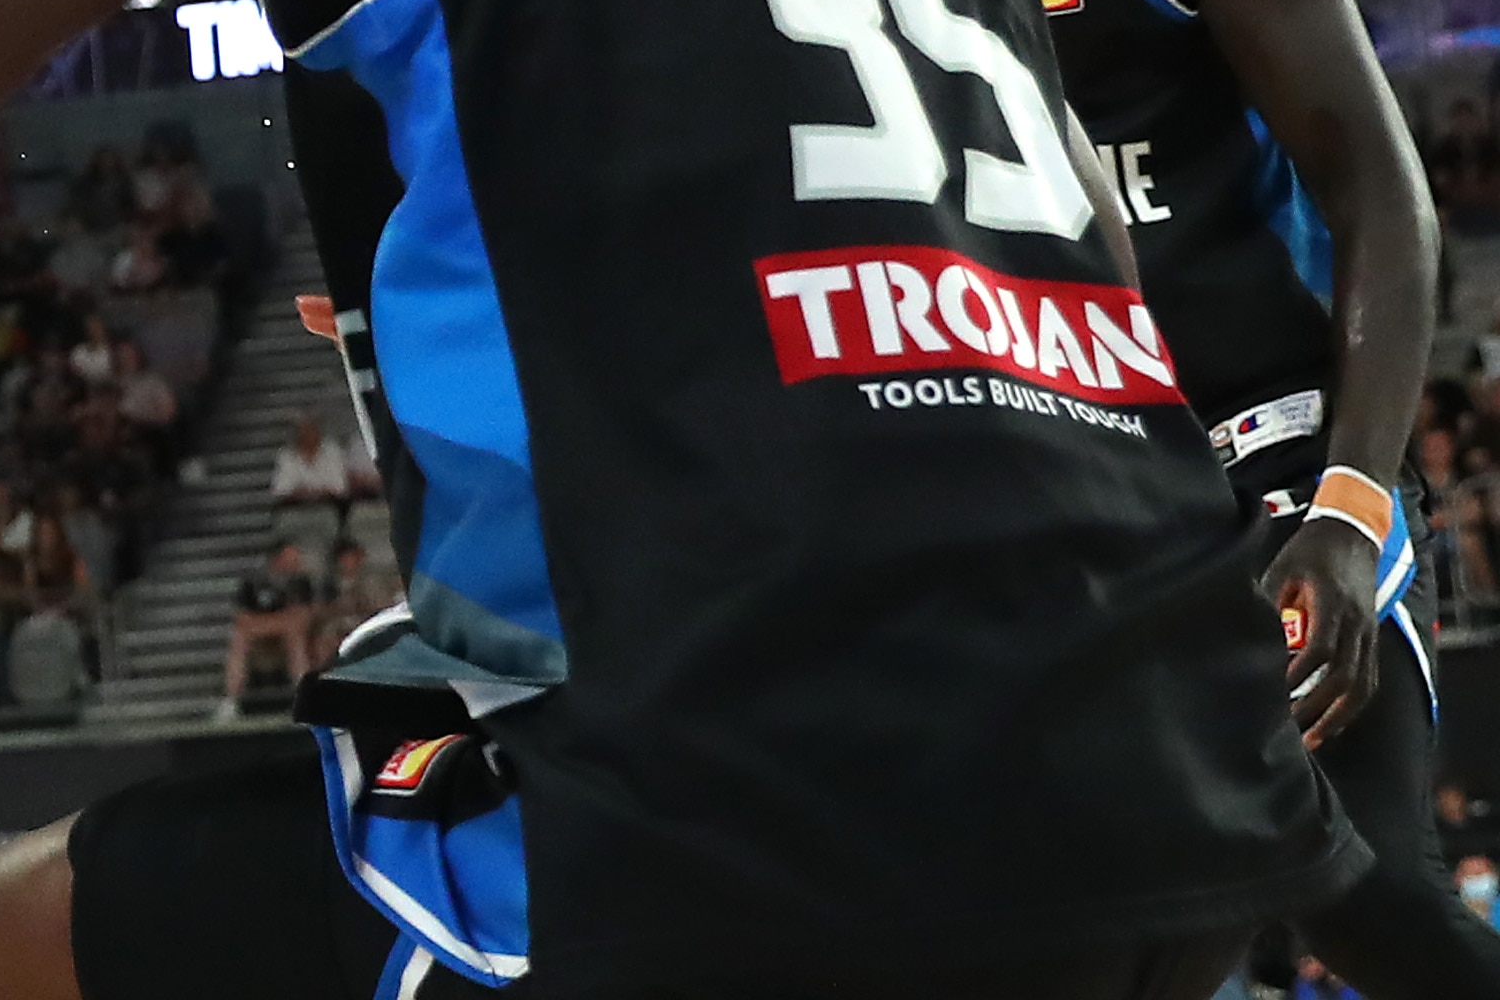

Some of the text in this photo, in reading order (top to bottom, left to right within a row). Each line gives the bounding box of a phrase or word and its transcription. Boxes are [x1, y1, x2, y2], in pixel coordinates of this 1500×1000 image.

[765, 261, 1176, 390] TROJAN
[858, 377, 1148, 440] TOOLS BUILT TOUGH
